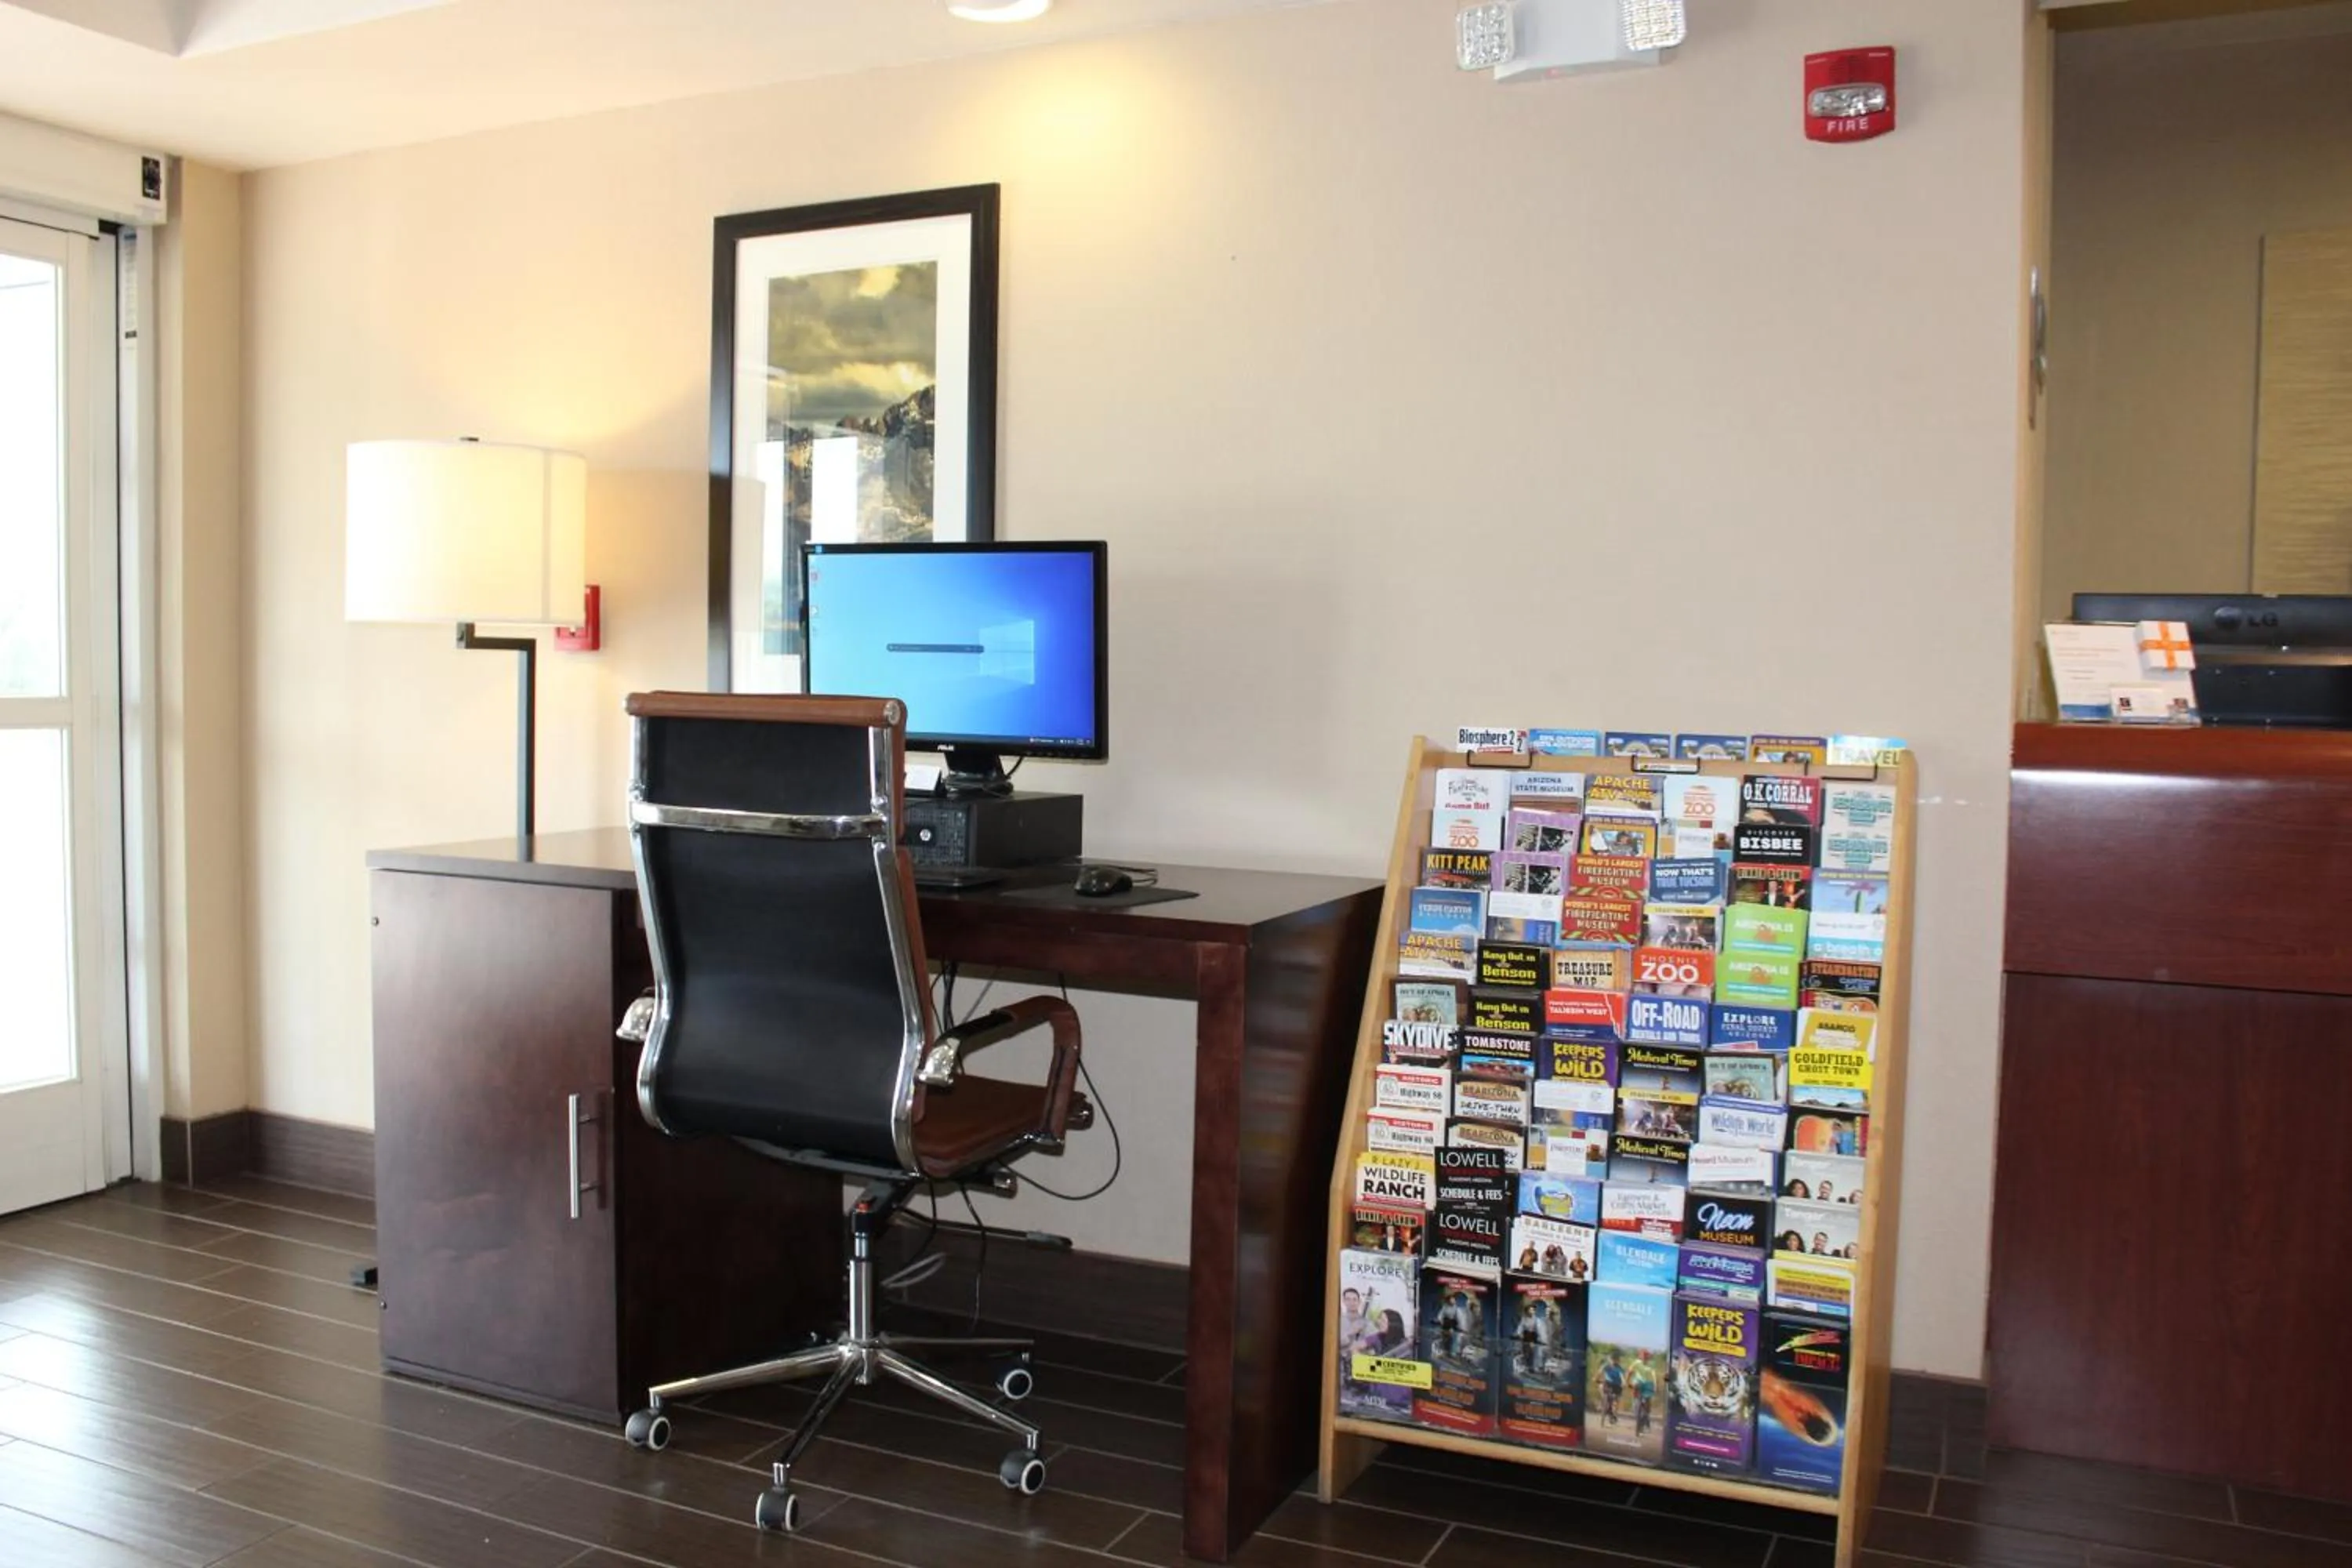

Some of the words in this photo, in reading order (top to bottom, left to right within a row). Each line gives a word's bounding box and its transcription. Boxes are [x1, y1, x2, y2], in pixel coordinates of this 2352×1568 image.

[1827, 118, 1869, 133] FIRE
[2248, 611, 2279, 627] LG
[1459, 729, 1508, 746] Biosphere
[1509, 730, 1515, 746] 2
[1595, 775, 1650, 789] APACHE
[1766, 784, 1813, 804] CORRAL
[1684, 802, 1715, 815] ZOO
[1450, 836, 1479, 848] ZOO
[1739, 837, 1803, 851] BISBEE
[1427, 854, 1453, 869] KITT
[1457, 855, 1490, 872] PEAK
[1577, 866, 1642, 877] FIREFIGHTING
[1656, 869, 1679, 877] NOW
[1588, 877, 1631, 887] MUSEUM
[1566, 909, 1631, 921] FIREFIGHTING
[1577, 920, 1618, 931] MUSEUM
[1406, 934, 1462, 948] APACHE
[1483, 949, 1506, 962] Hang
[1641, 953, 1699, 965] PHOENIX
[1482, 965, 1537, 980] Benson
[1557, 962, 1613, 976] TREASURE
[1640, 963, 1700, 983] ZOO
[1573, 976, 1597, 987] MAP
[1475, 1001, 1499, 1013] Hang
[1475, 1015, 1530, 1031] Benson
[1722, 1012, 1776, 1025] EXPLORE
[1465, 1036, 1531, 1052] TOMBSTONE
[1552, 1042, 1606, 1058] KEEPERS
[1795, 1052, 1864, 1067] GOLDFIELD
[1554, 1058, 1606, 1078] WILD
[1798, 1064, 1829, 1074] GHOST
[1832, 1066, 1860, 1076] TOWN
[1462, 1084, 1519, 1099] BEARIZONA
[1439, 1152, 1500, 1168] LOWELL
[1364, 1166, 1427, 1185] WILDLIFE
[1363, 1178, 1426, 1200] RANCH
[1439, 1186, 1475, 1199] SCHEDULE
[1477, 1189, 1484, 1200] &
[1697, 1202, 1755, 1231] Neon
[1439, 1213, 1500, 1236] LOWELL
[1700, 1231, 1755, 1245] MUSEUM
[1349, 1261, 1403, 1278] EXPLORE
[1687, 1304, 1744, 1325] KEEPERS
[1686, 1320, 1743, 1344] WILD
